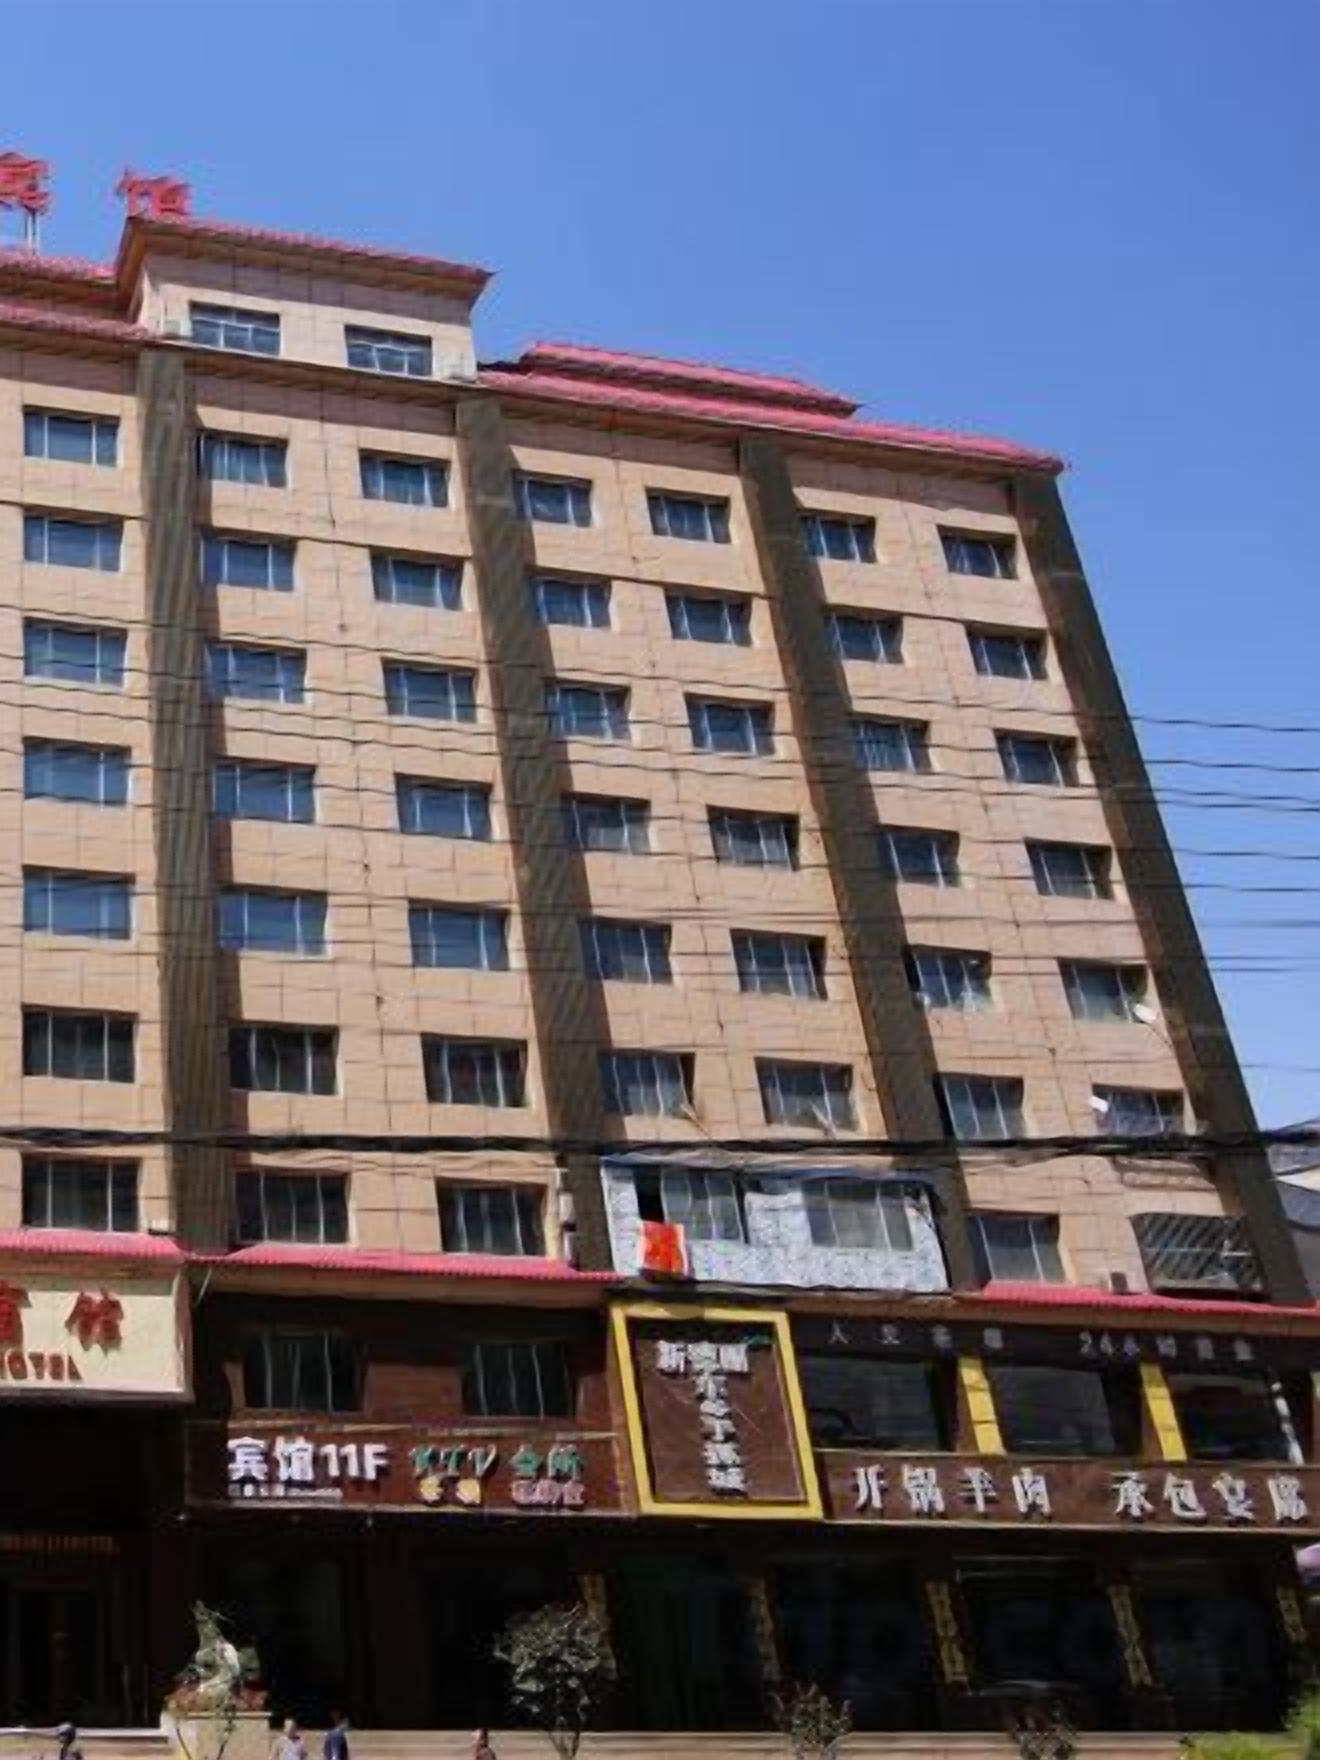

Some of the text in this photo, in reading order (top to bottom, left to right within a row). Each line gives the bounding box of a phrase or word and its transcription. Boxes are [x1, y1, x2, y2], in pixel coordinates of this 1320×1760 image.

[853, 1463, 1052, 1514] 开锅羊肉
[1111, 1472, 1309, 1521] 承包宴席
